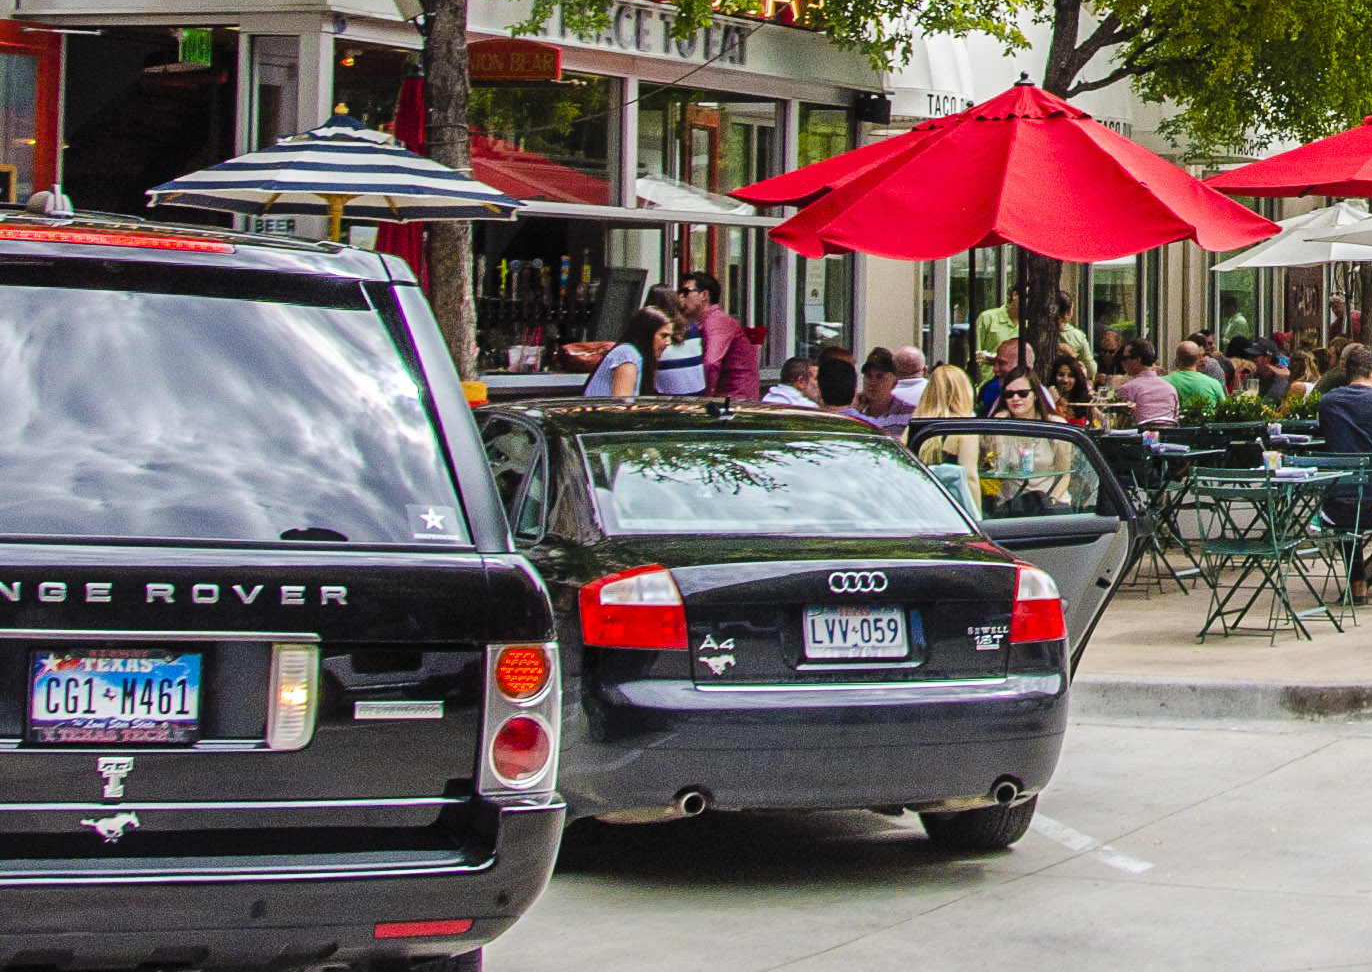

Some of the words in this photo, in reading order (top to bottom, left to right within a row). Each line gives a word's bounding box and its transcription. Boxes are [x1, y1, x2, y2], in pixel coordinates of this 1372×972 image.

[926, 93, 957, 116] TACO
[255, 218, 295, 233] BEER
[145, 582, 348, 606] ROVER
[699, 634, 735, 651] A4
[80, 657, 154, 673] TEXAS
